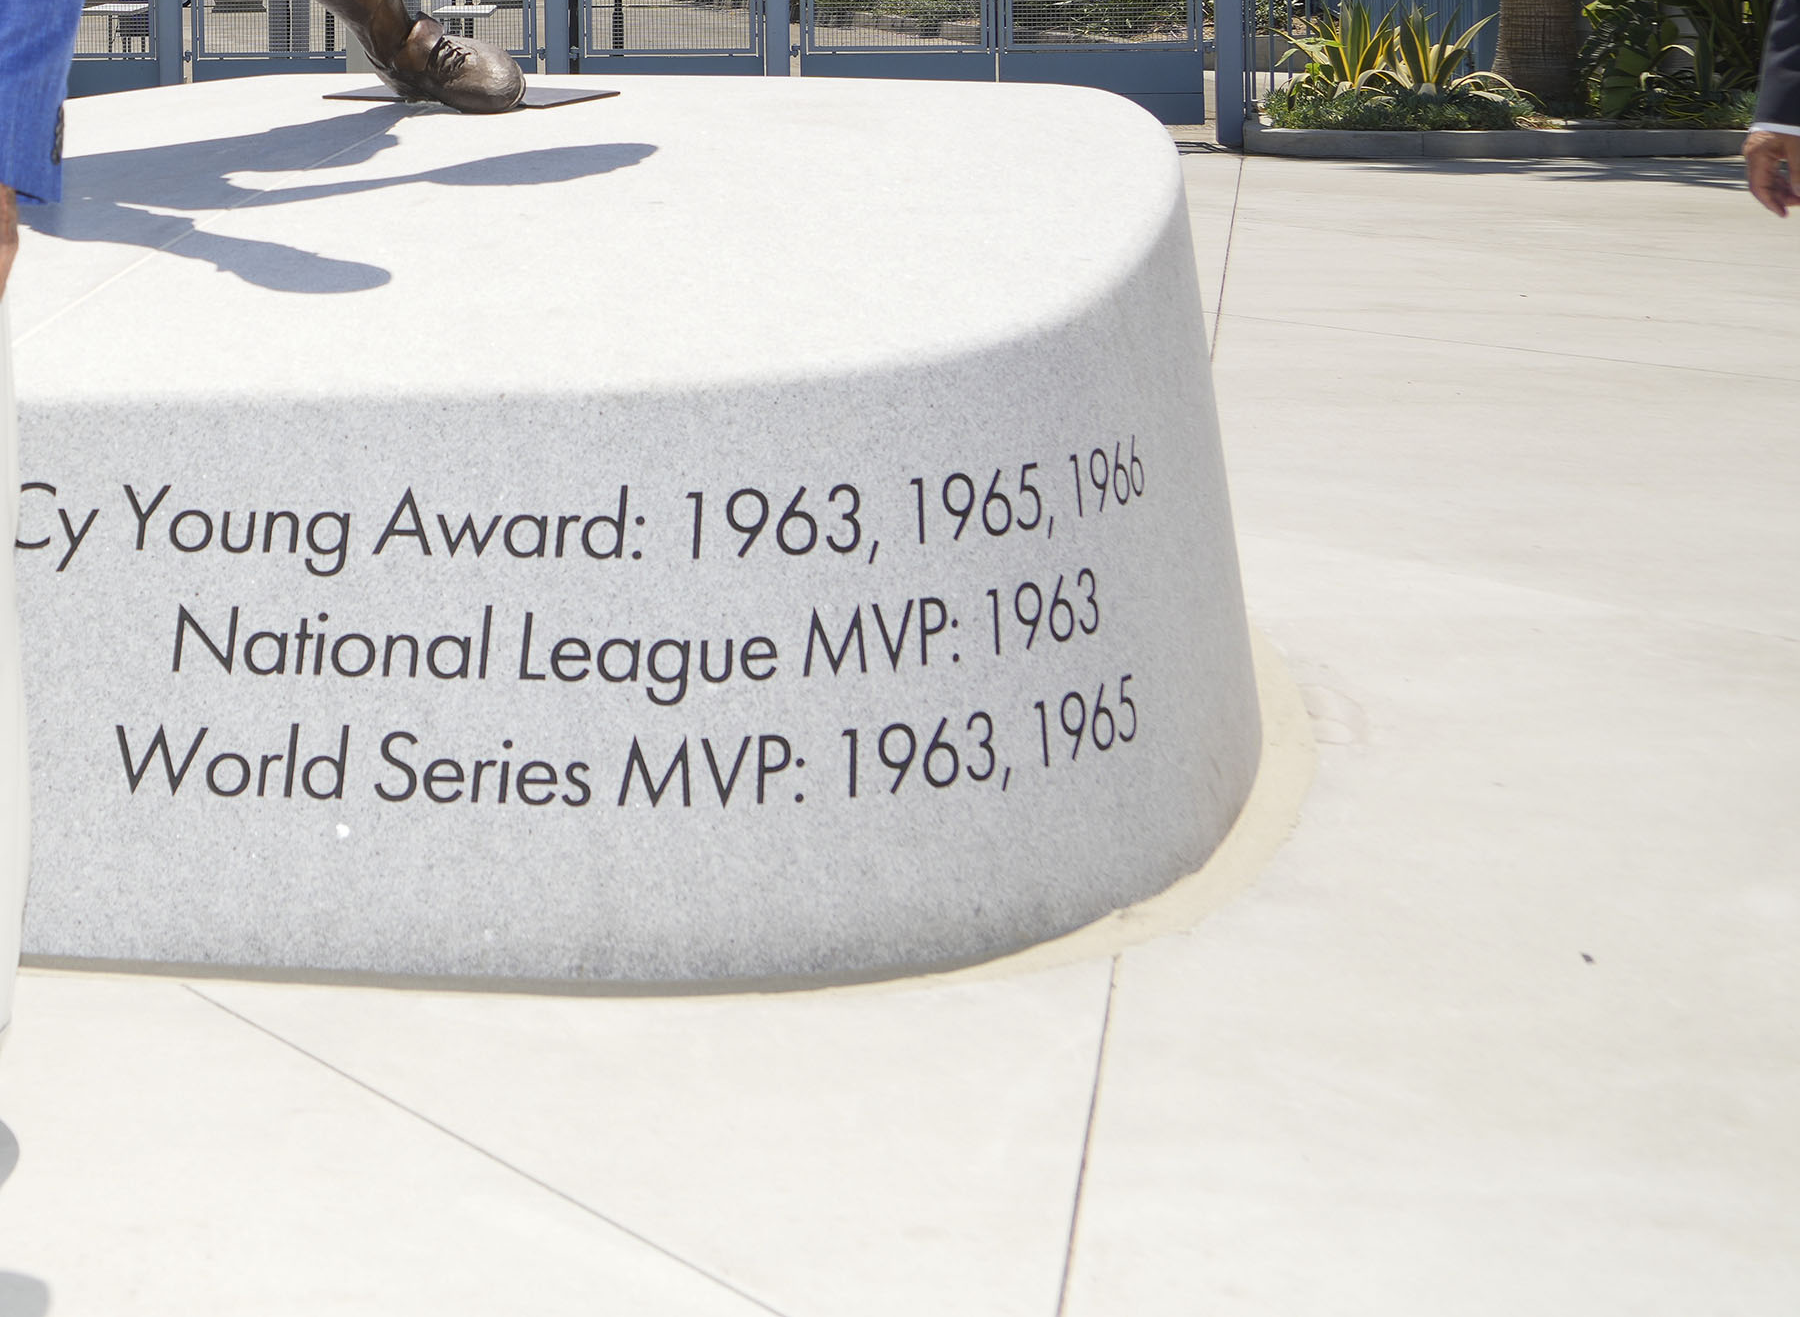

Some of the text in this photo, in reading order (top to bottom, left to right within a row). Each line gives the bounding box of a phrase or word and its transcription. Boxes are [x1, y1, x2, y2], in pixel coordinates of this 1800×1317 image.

[14, 434, 1145, 578] Cy Young Award: 1963, 1965, 1966
[171, 567, 1099, 708] National League MVP: 1963
[115, 674, 1137, 809] World Series MVP: 1963, 1965
